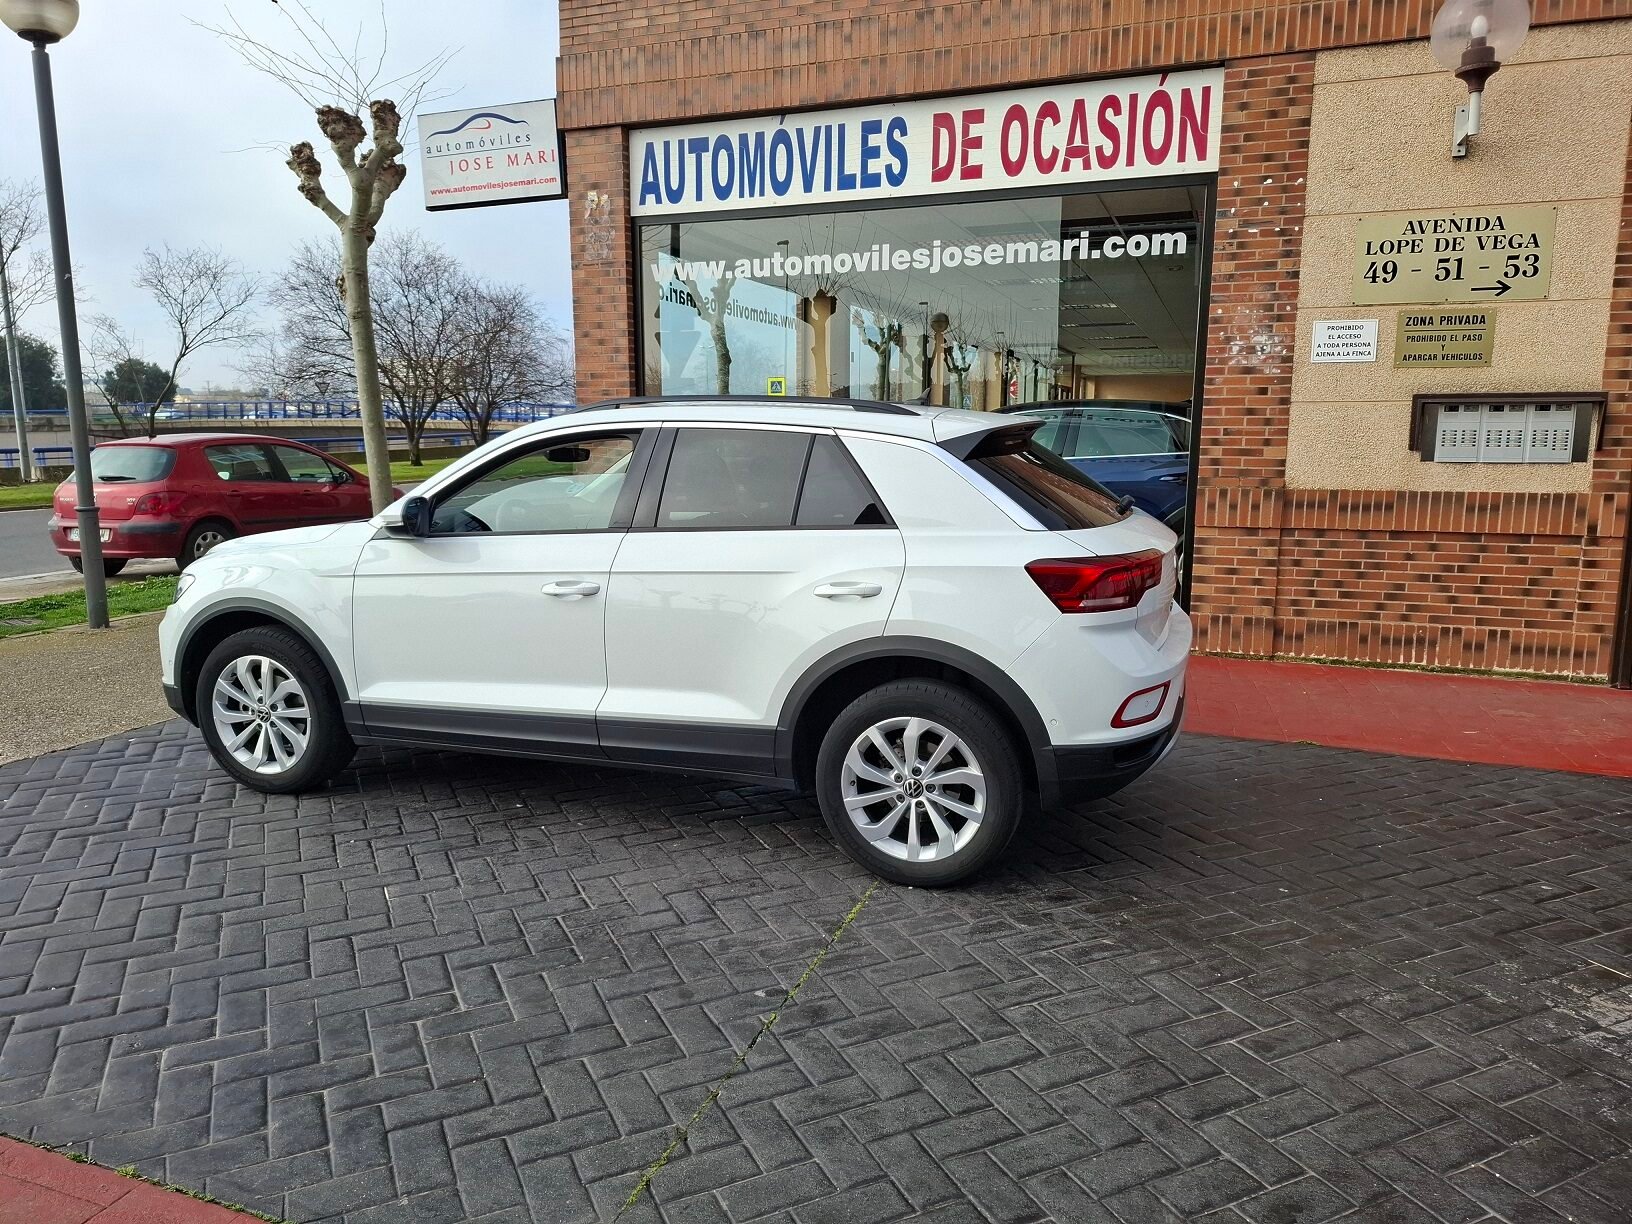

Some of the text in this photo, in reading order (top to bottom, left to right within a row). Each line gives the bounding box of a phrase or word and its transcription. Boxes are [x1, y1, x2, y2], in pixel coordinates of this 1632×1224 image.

[426, 133, 531, 153] automóviles
[639, 73, 1212, 206] AUTOMÓVILES DE OCASIÓN
[450, 149, 556, 175] JOSE MARI
[430, 176, 557, 195] www.automovilesjosemari.com
[1402, 216, 1505, 235] AVENIDA
[1365, 233, 1540, 255] LOPE DE VEGA
[650, 231, 1187, 281] www.automovilesjosemari.com
[1364, 260, 1398, 283] 49
[1435, 257, 1465, 281] 51
[1504, 254, 1540, 278] 53
[1406, 315, 1486, 326] ZONA PRIVADA
[1407, 334, 1446, 342] PROHIBIDO
[1441, 353, 1483, 361] VEHICULOS
